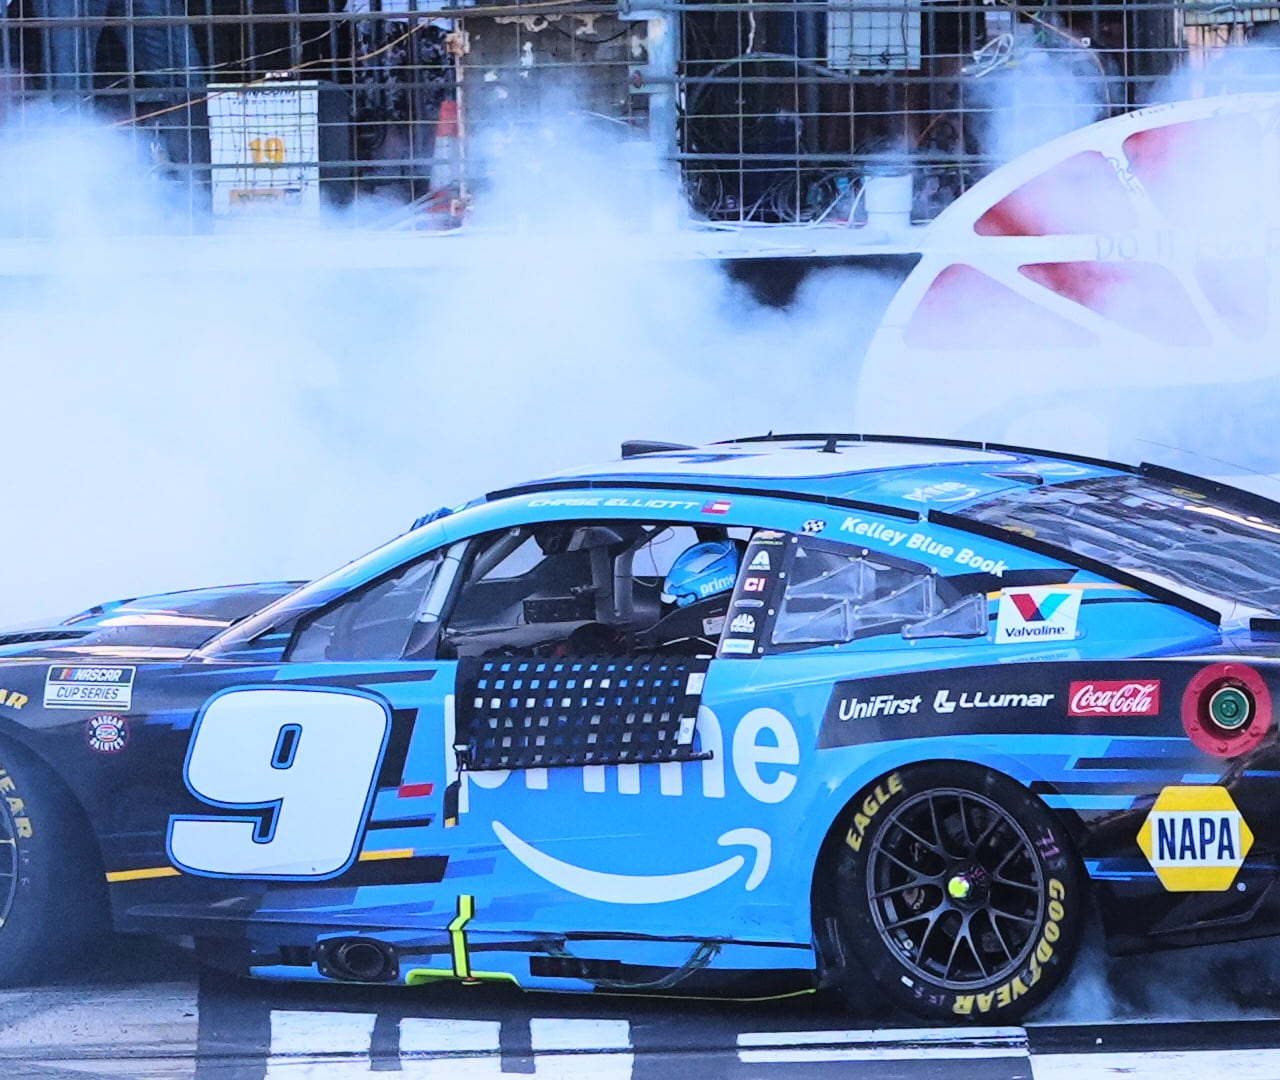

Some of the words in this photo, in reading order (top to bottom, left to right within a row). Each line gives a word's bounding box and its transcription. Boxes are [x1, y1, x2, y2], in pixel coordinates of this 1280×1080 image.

[527, 497, 601, 508] CHASE
[603, 497, 701, 510] ELLIOTT
[839, 516, 908, 547] Kelley
[906, 531, 954, 559] Blue
[954, 546, 1009, 578] Book
[1004, 625, 1066, 639] Valvoline
[56, 687, 78, 699] CUP
[79, 687, 120, 700] SERIES
[74, 668, 123, 682] NASCAR
[838, 694, 922, 721] UniFirst
[1070, 683, 1159, 713] Coca-Cola
[444, 694, 801, 814] pme
[167, 684, 392, 881] 9
[846, 772, 904, 852] EAGLE
[1157, 817, 1236, 861] NAPA
[952, 878, 1066, 1015] GOODYEAR
